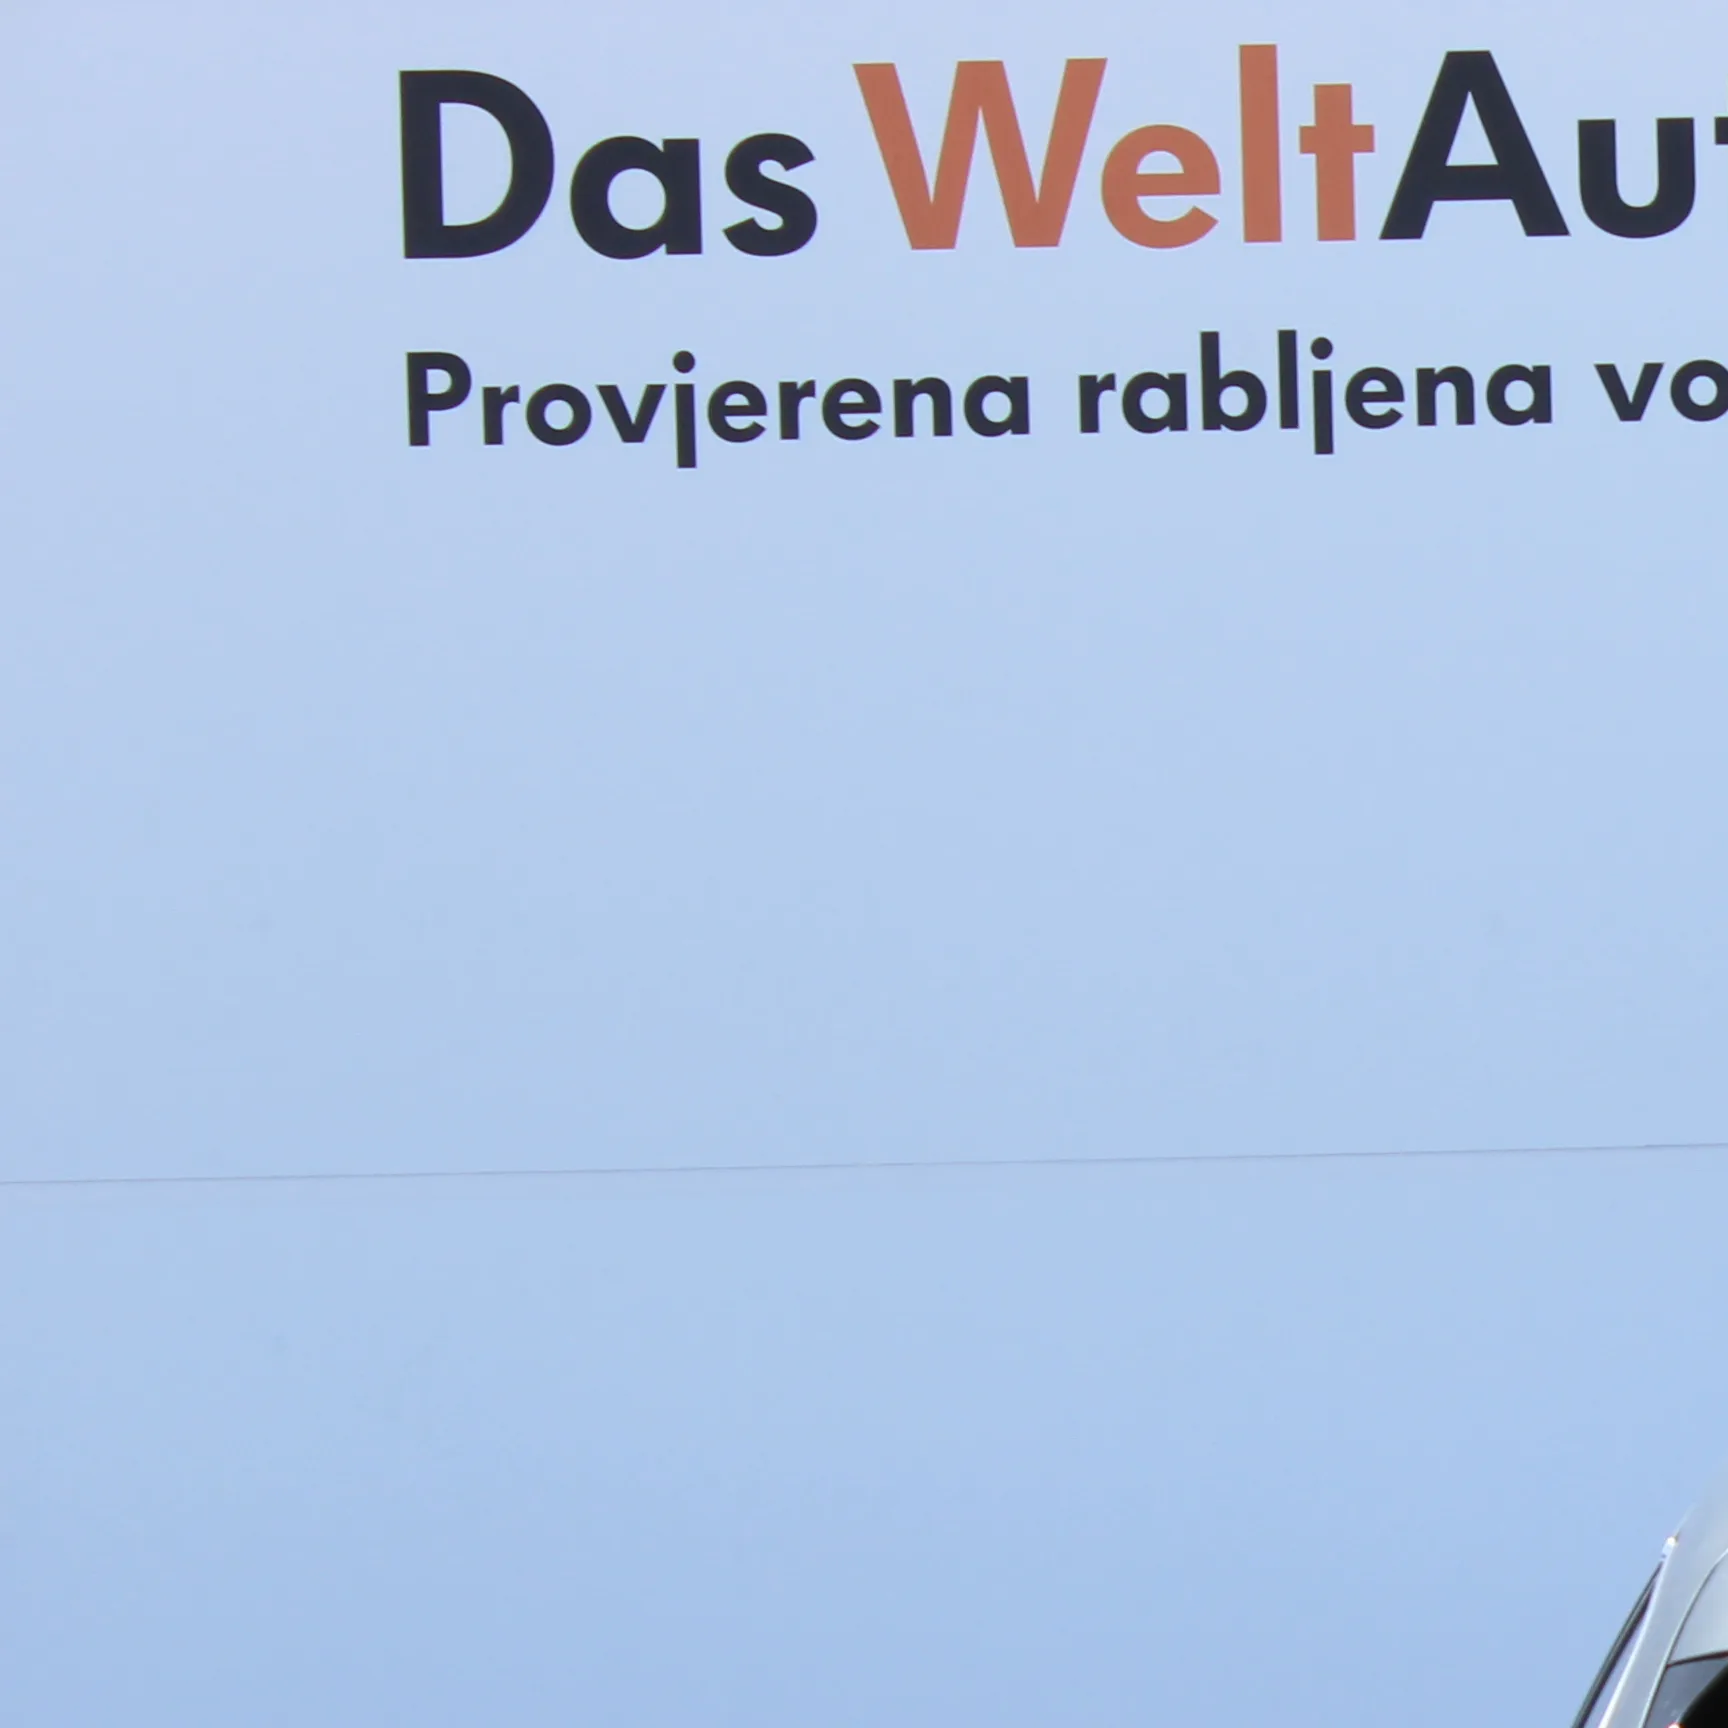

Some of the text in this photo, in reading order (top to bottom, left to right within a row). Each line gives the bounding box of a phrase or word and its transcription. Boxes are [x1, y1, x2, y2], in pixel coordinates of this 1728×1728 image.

[397, 68, 818, 260] Das
[405, 349, 1031, 470] Provjerena
[1077, 329, 1553, 456] rabljena
